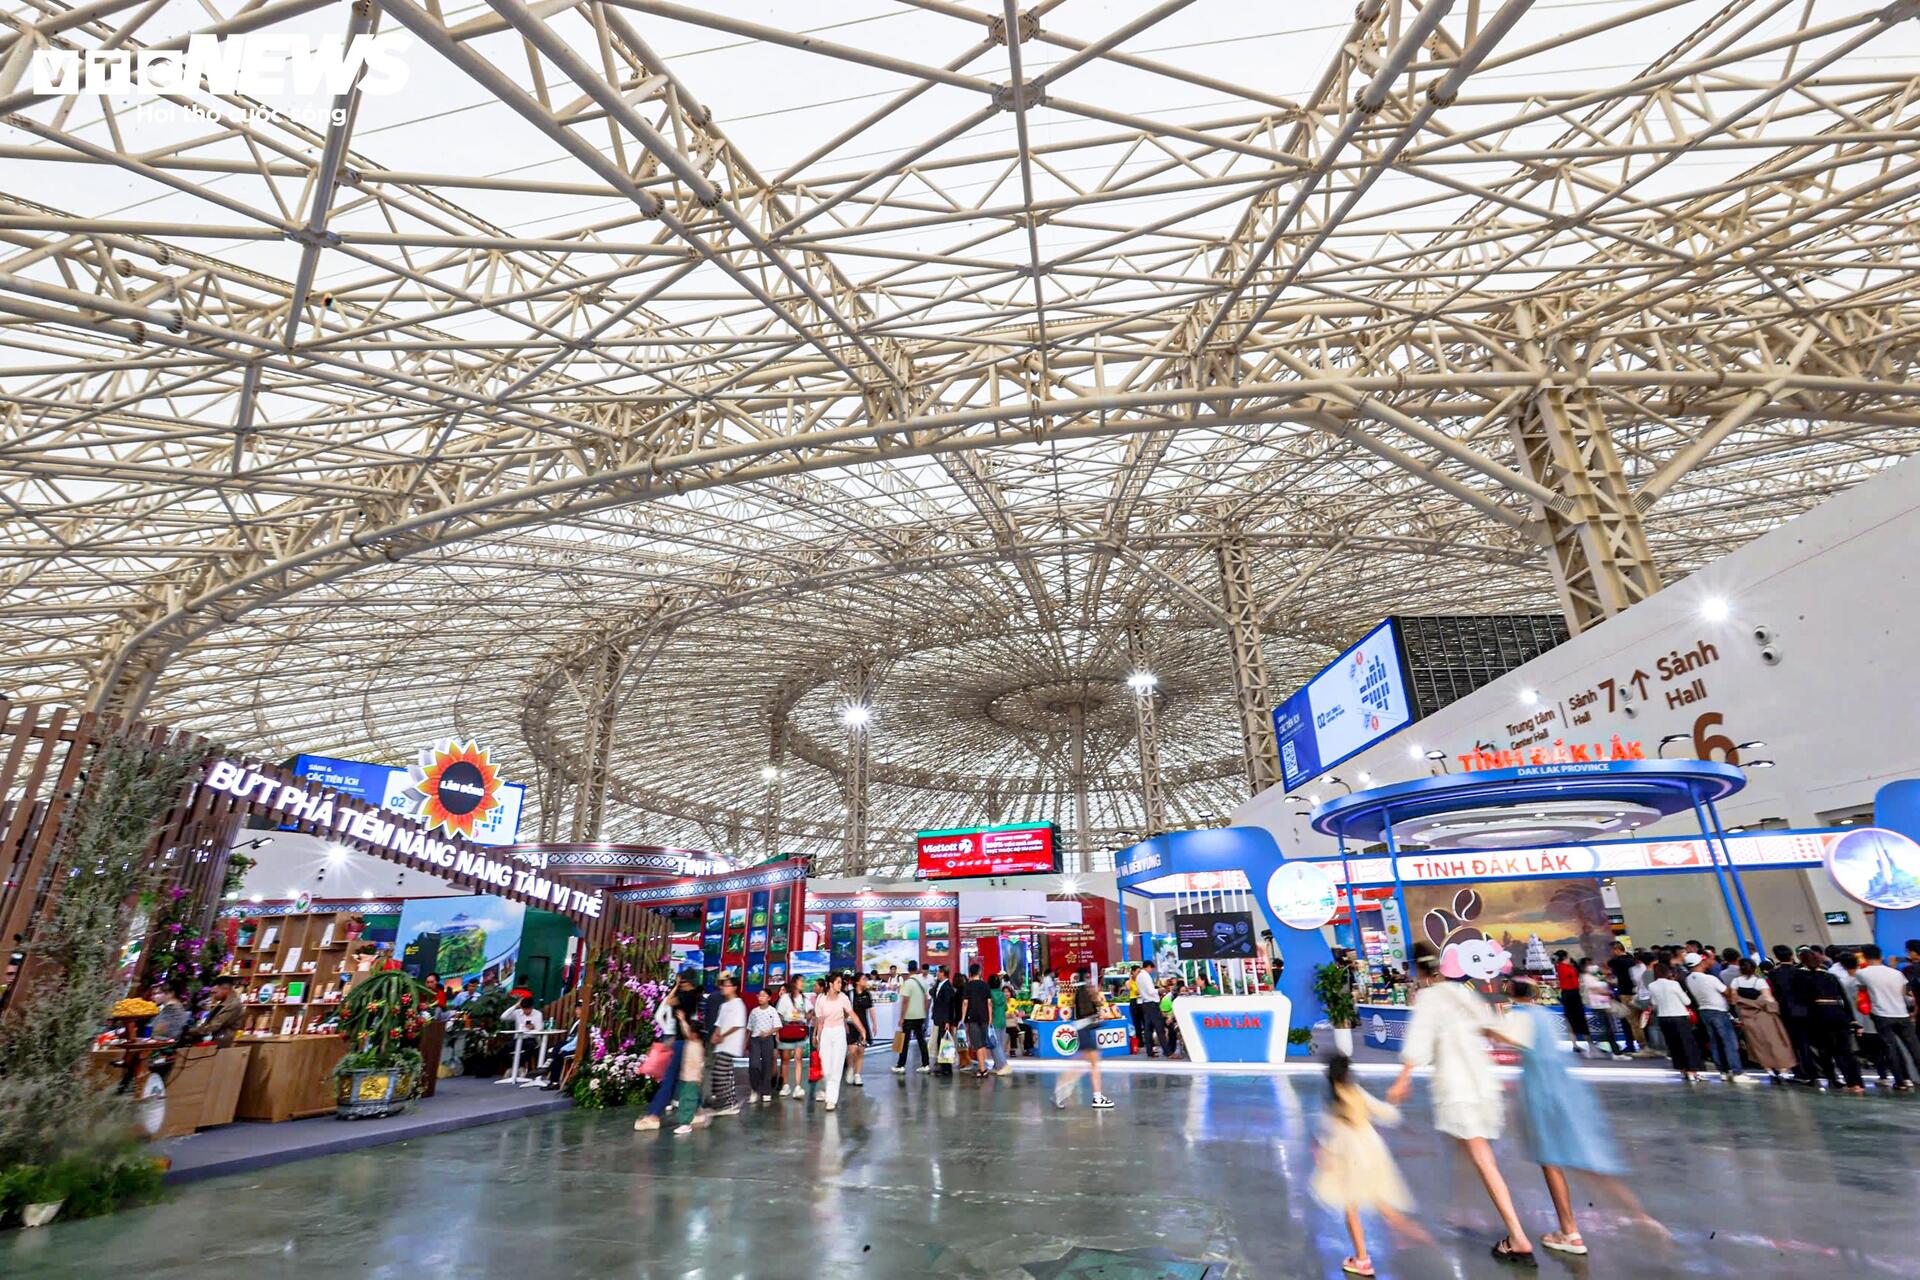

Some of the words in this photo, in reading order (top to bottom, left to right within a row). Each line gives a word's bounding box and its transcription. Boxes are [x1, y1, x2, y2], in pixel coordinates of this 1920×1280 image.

[1657, 640, 1720, 681] Sảnh
[1569, 690, 1598, 710] Sảnh
[1598, 678, 1615, 713] 7
[1665, 678, 1708, 710] Hall
[1506, 718, 1535, 738] Trung
[1534, 709, 1556, 725] tâm
[1573, 711, 1592, 727] Hall
[1534, 728, 1550, 743] Hall
[1693, 712, 1740, 767] 6
[1517, 766, 1540, 776] DAK
[1540, 764, 1561, 775] LAK
[1561, 763, 1610, 774] PROVINCE
[390, 796, 406, 808] 02
[206, 761, 282, 805] BỨT
[276, 785, 334, 827] PHÁ
[392, 828, 457, 868] NĂNG
[552, 883, 571, 911] VỊ
[571, 889, 603, 918] THẾ
[922, 843, 958, 853] Vietlott
[1097, 1031, 1125, 1045] OCOP
